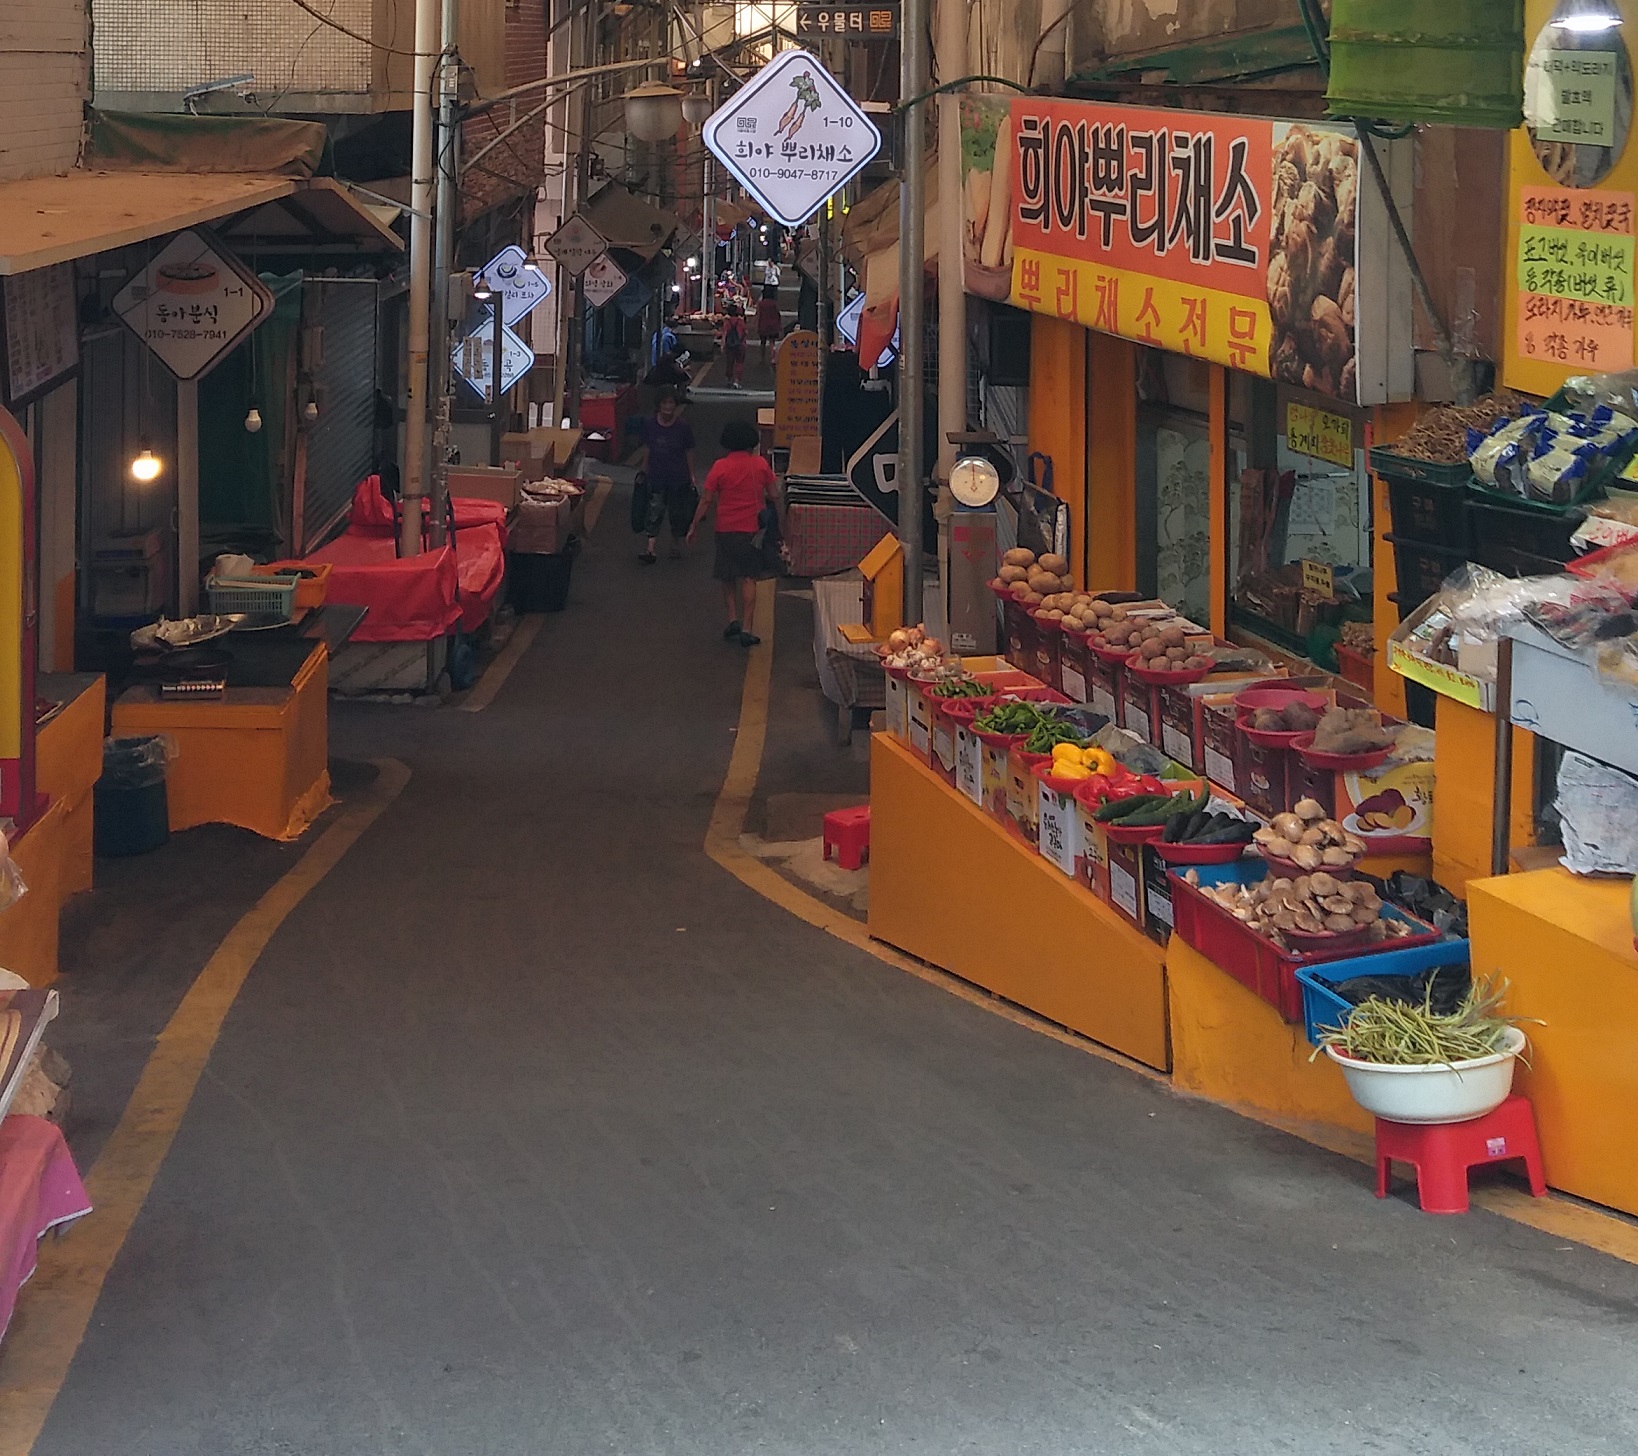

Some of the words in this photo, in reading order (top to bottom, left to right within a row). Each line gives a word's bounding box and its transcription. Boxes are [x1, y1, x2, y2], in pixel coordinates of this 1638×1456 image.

[823, 117, 853, 128] 1-10
[735, 140, 773, 159] 희야
[780, 141, 853, 163] 뿌리채소
[750, 168, 838, 181] 010-9047-8717
[1018, 115, 1261, 268] 희야뿌리채소
[224, 287, 243, 297] 1-1
[156, 304, 218, 324] 동아분식
